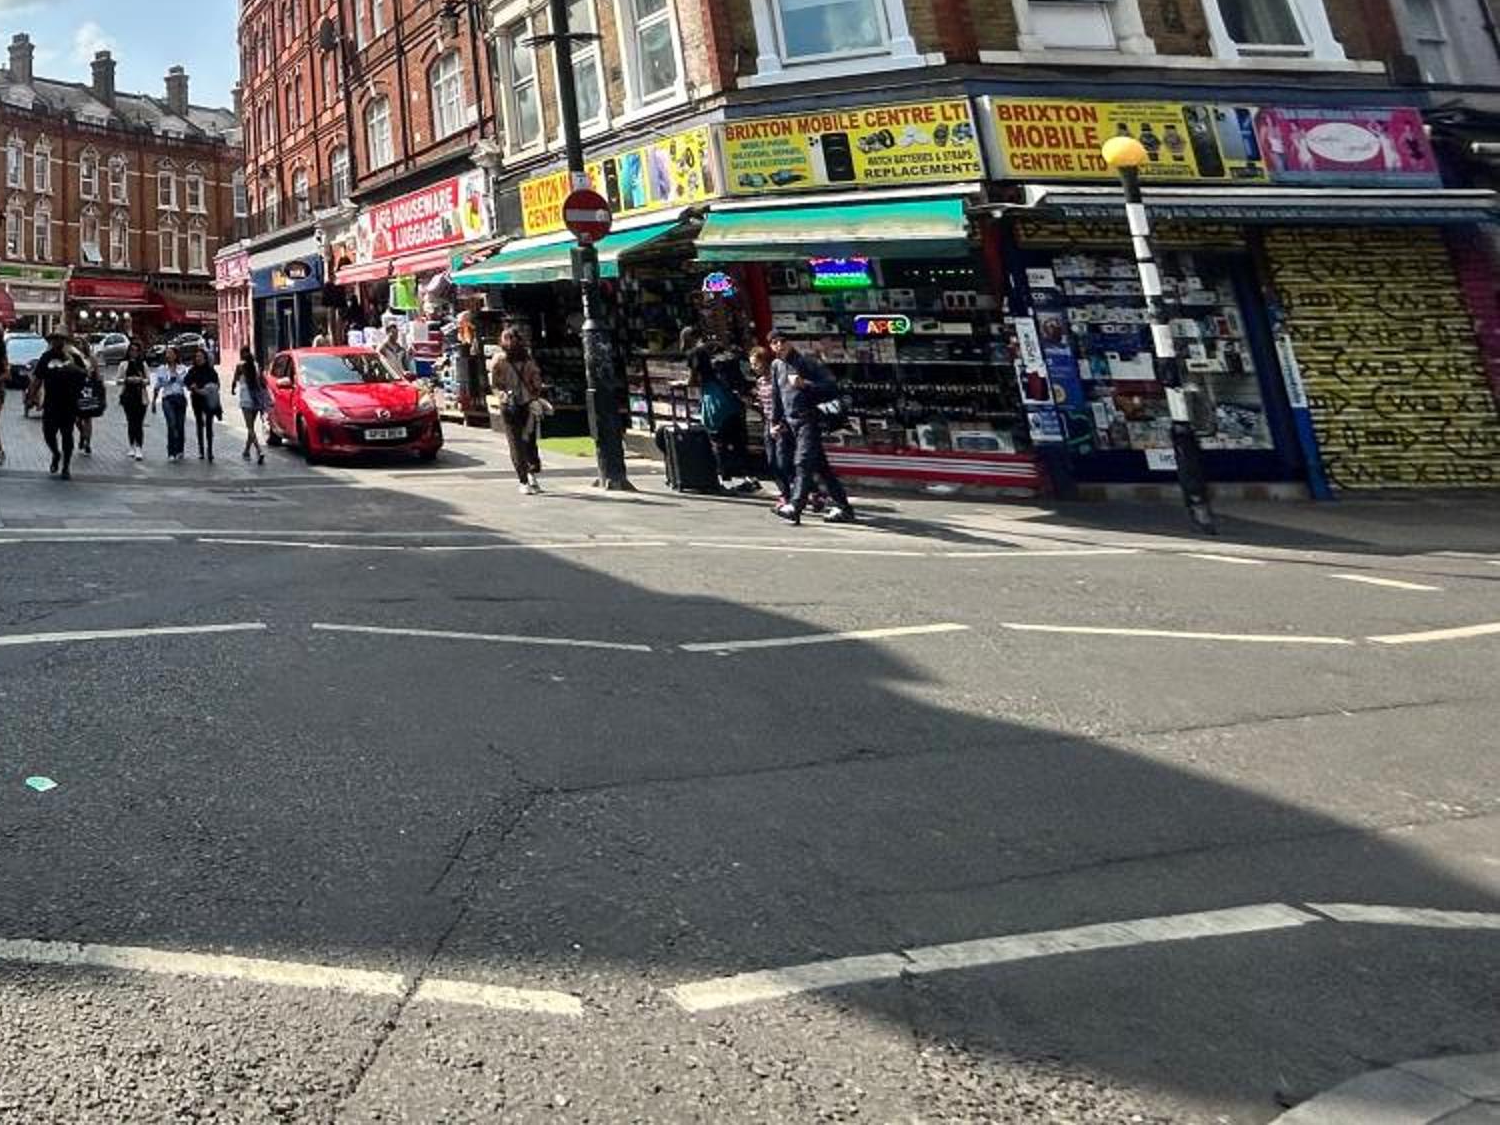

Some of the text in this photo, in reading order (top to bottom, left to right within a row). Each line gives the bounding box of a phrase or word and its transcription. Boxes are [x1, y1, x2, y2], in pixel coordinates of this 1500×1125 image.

[725, 124, 793, 142] BRIXTON
[797, 113, 859, 134] MOBILE
[864, 105, 934, 128] CENTRE
[997, 104, 1099, 124] BRIXTON
[1005, 125, 1101, 149] MOBILE
[864, 162, 981, 179] REPLACEMENTS
[1010, 152, 1108, 172] CENTRE LTD
[393, 186, 453, 226] HOUSEWARE
[528, 206, 561, 230] CENTR
